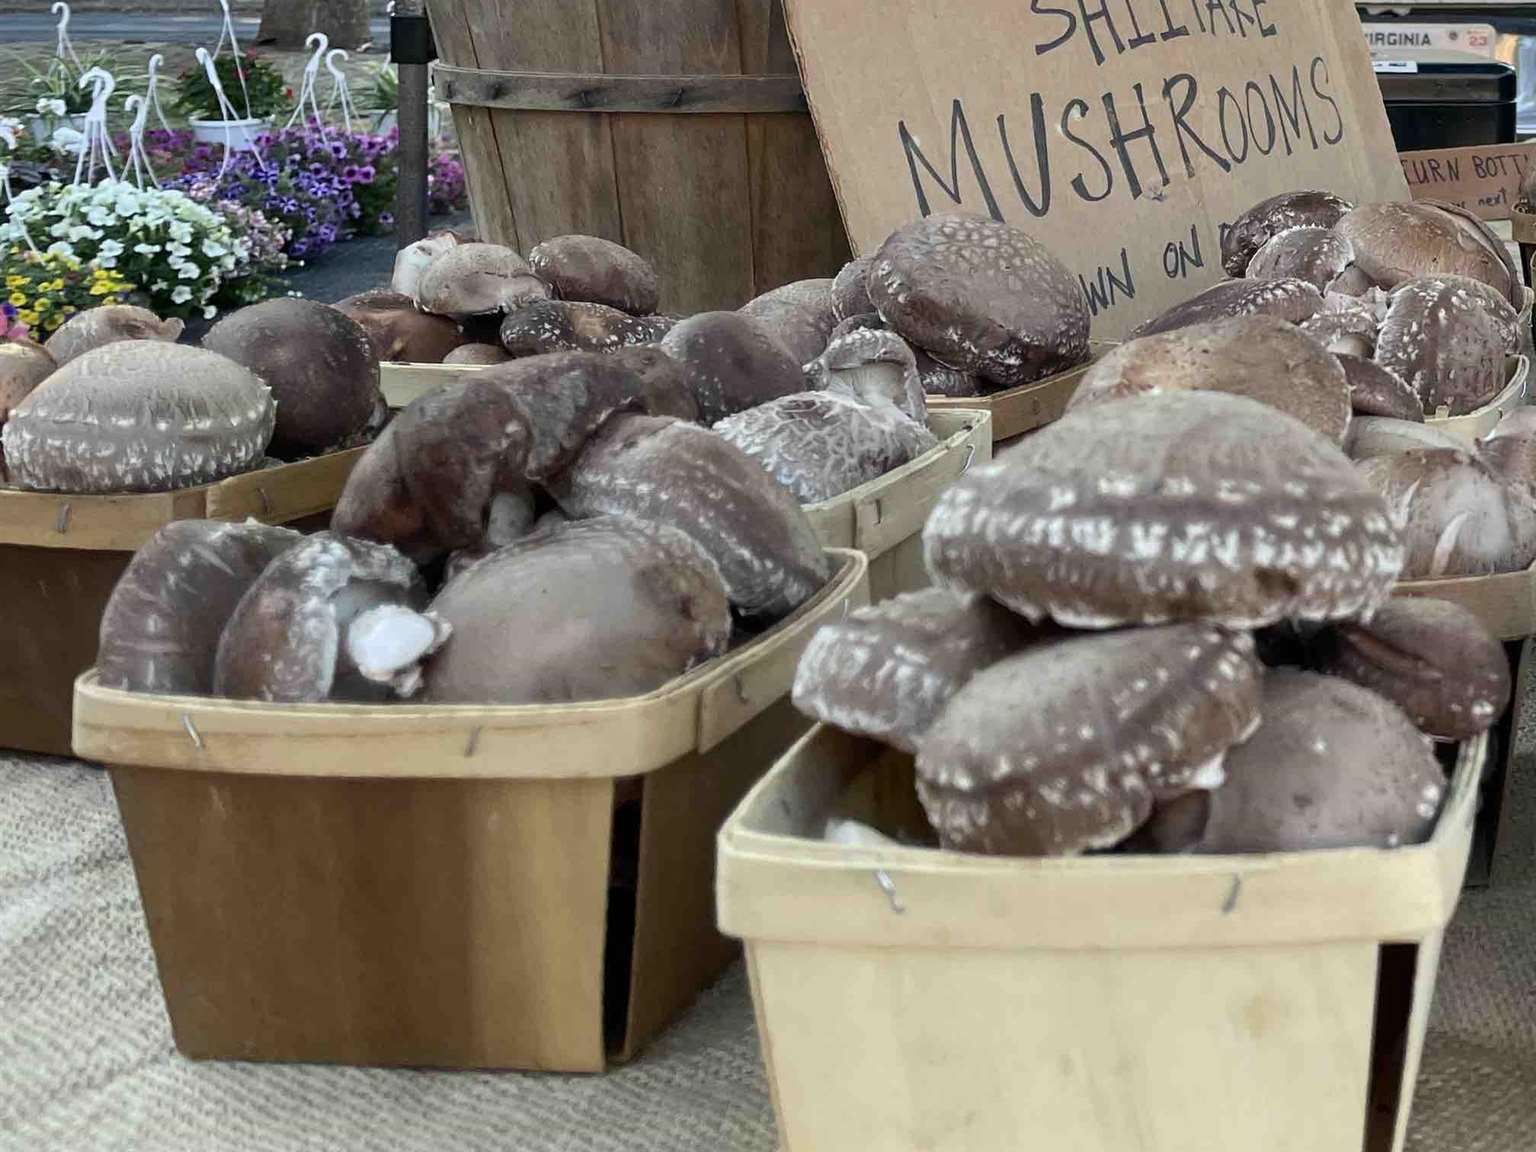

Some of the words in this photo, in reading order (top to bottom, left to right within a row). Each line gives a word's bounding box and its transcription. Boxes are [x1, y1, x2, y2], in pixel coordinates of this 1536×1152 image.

[1366, 32, 1432, 47] IRGINIA
[899, 56, 1344, 223] MUSHROOMS
[1162, 223, 1205, 278] ON
